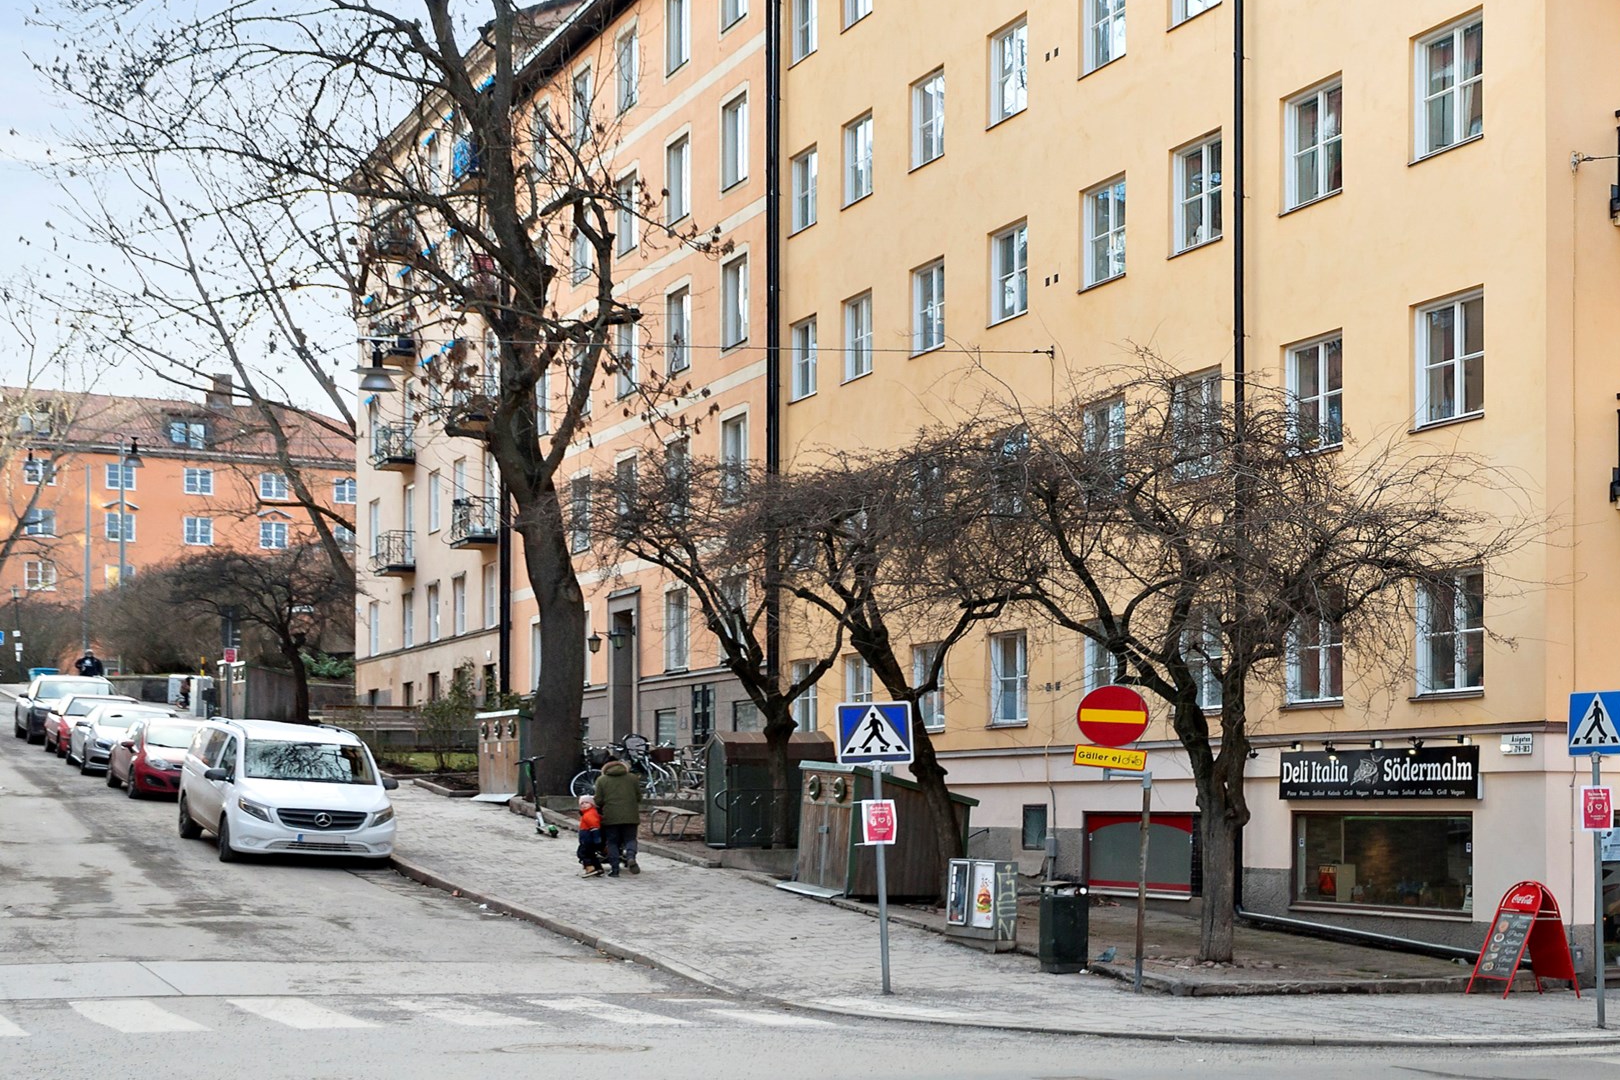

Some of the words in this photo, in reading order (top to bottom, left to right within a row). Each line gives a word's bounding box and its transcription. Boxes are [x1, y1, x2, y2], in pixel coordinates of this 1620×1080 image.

[1078, 751, 1109, 761] Gäller
[1112, 755, 1122, 764] ej
[1282, 761, 1309, 783] Deli
[1311, 759, 1348, 783] Italia
[1383, 756, 1473, 782] Södermalm
